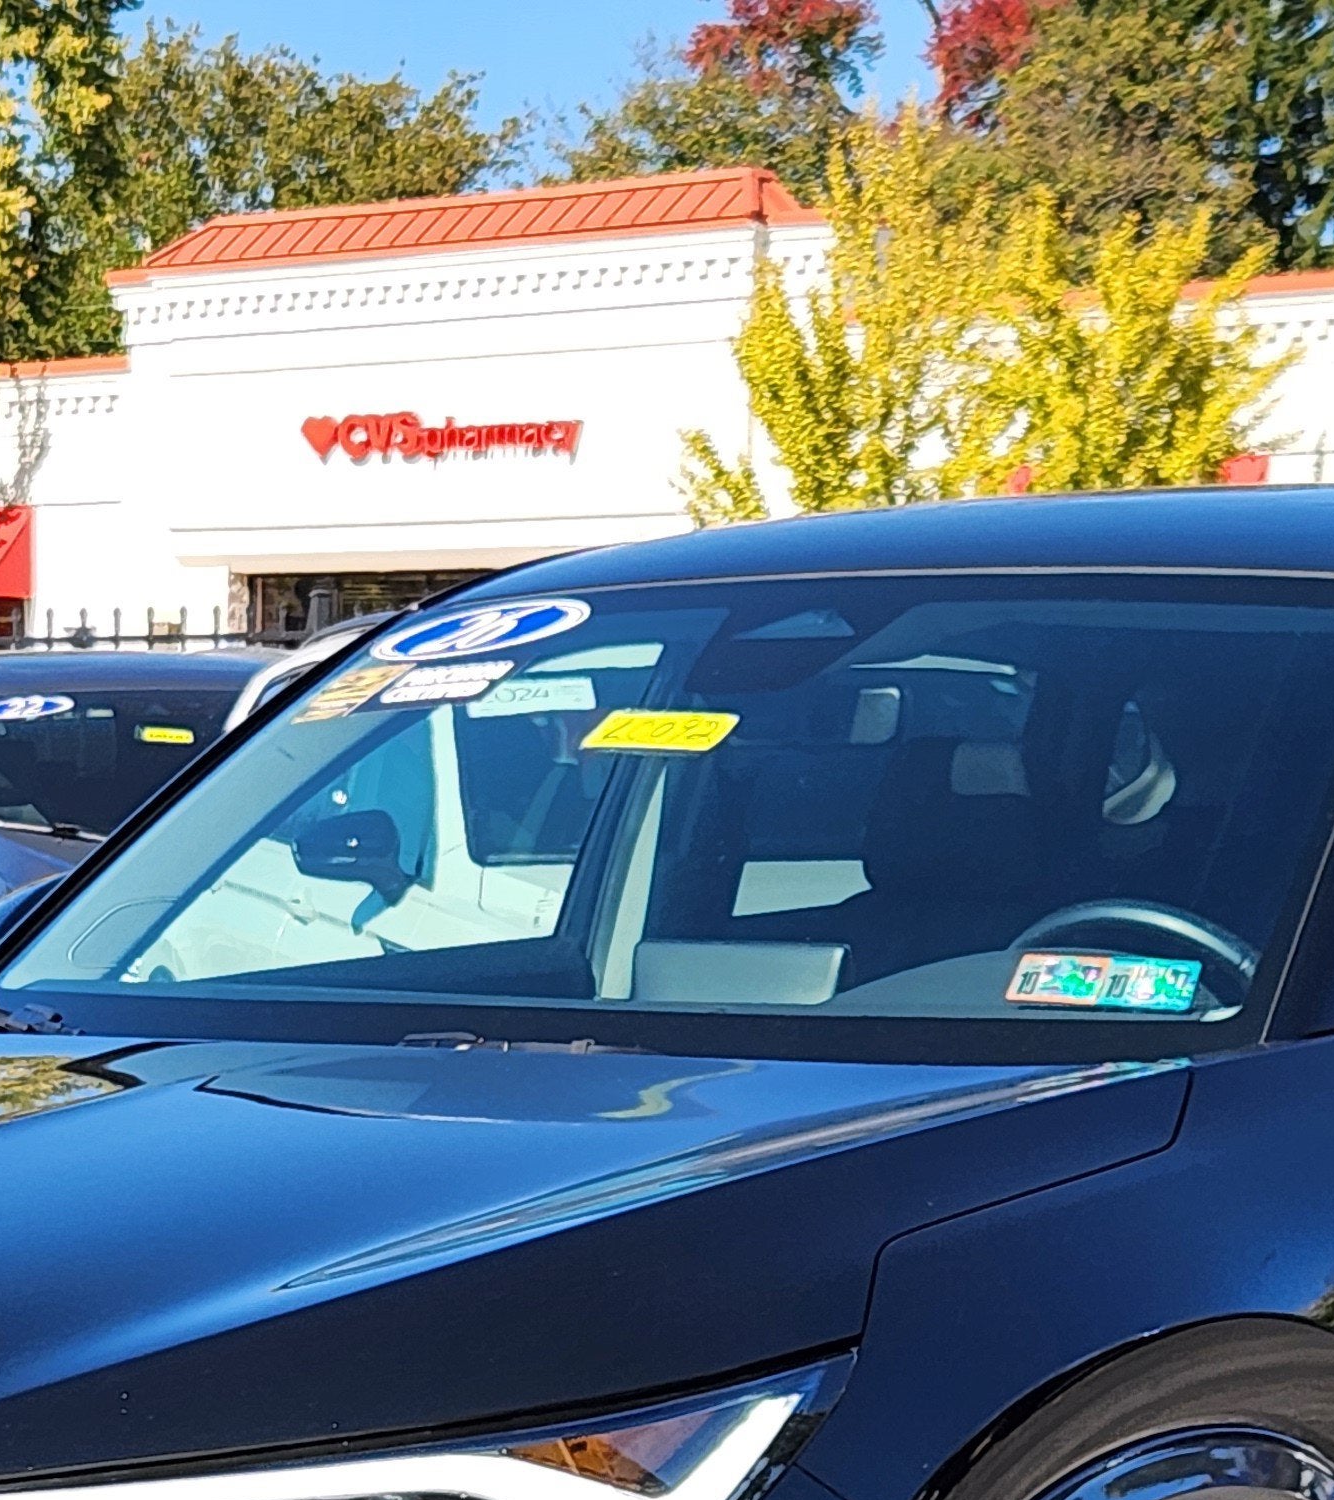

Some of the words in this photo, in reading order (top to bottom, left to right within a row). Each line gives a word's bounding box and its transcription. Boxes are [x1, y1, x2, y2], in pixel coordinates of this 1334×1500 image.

[337, 411, 420, 458] CVS
[1017, 970, 1041, 995] 10
[1105, 974, 1131, 998] 10
